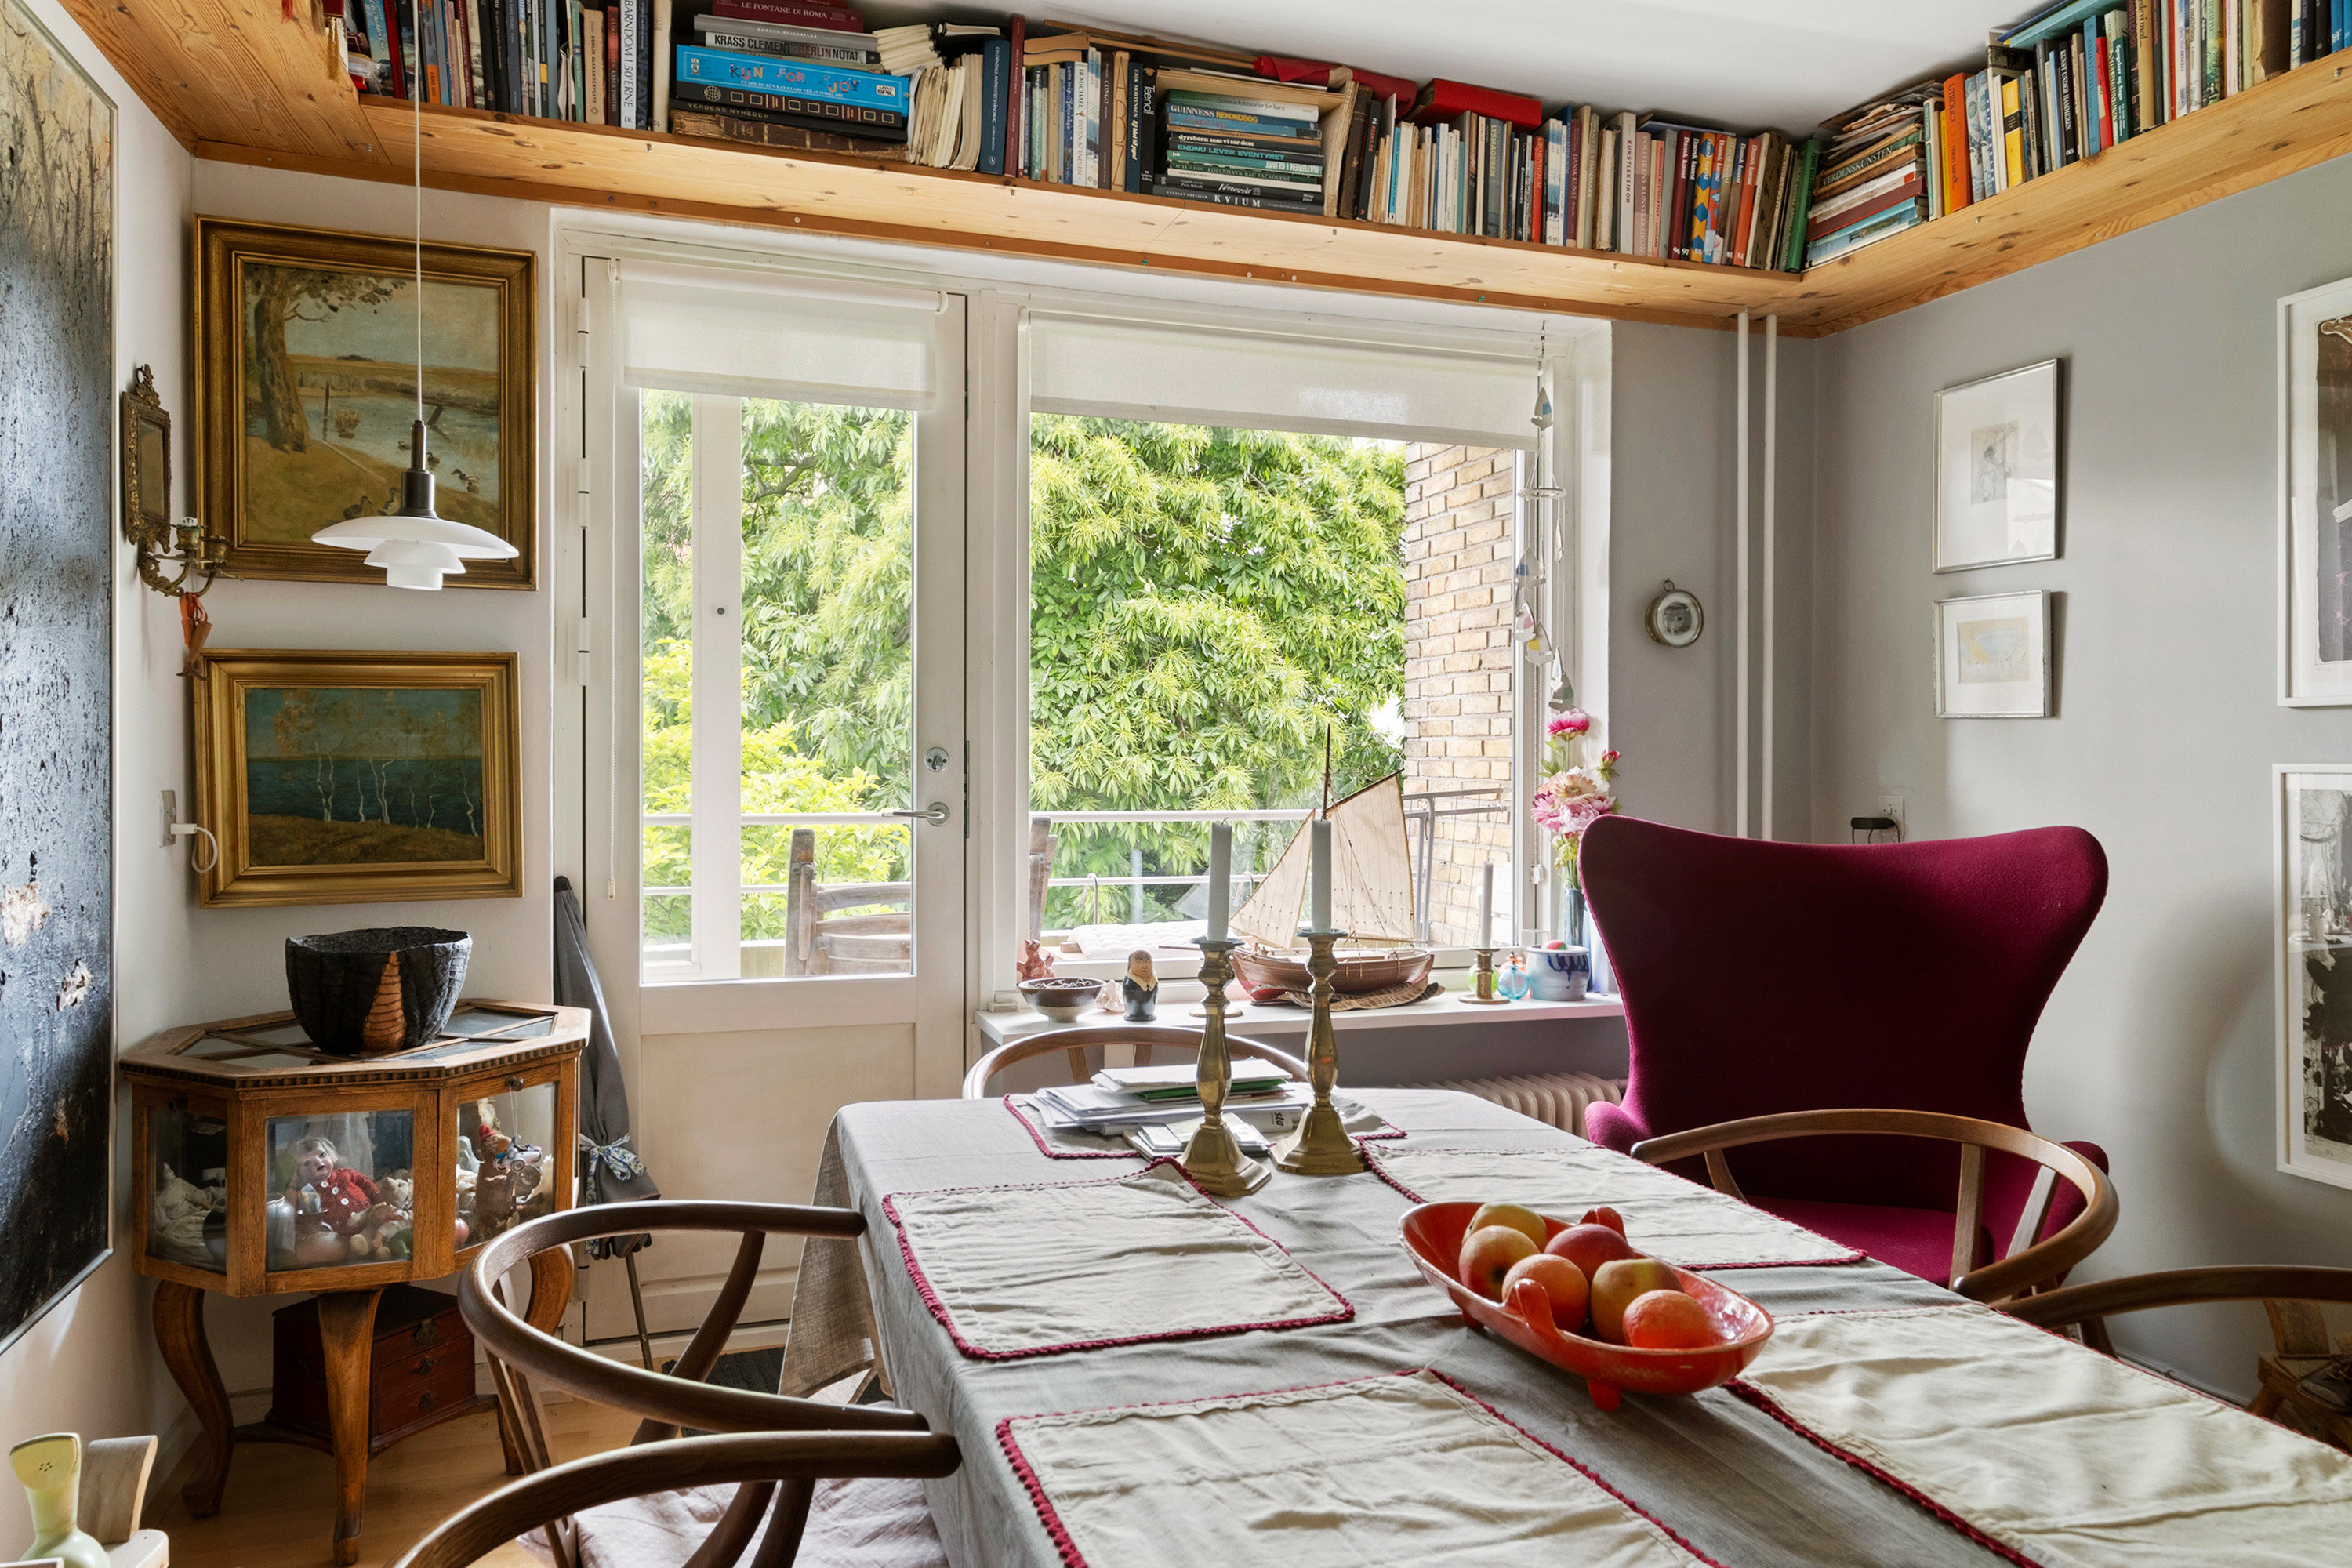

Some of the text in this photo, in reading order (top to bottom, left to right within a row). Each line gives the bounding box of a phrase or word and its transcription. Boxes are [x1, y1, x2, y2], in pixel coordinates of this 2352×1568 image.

[753, 3, 791, 14] FONTANE
[804, 9, 828, 20] ROMA
[624, 0, 633, 56] BARNDOM
[714, 34, 745, 48] KRASS
[747, 38, 792, 53] CLEMENT
[2060, 49, 2068, 71] KUNST
[729, 63, 764, 81] KUN
[777, 67, 806, 85] FOR
[2061, 71, 2070, 95] UNDER
[624, 66, 633, 107] 50'ERNE
[688, 103, 770, 118] VERDENS NYHEDER
[1170, 104, 1258, 123] GUINNESS REKORDBOG
[2063, 95, 2071, 131] HAMMEREN
[1177, 144, 1285, 160] ENDNU LEVER EVENTYRET
[1681, 136, 1690, 158] Dansk
[1691, 138, 1700, 159] Dansk
[1704, 138, 1713, 159] Dansk
[1716, 140, 1726, 162] Dansk
[1738, 143, 1747, 163] Dansk
[1749, 144, 1758, 165] Dansk
[1290, 163, 1319, 174] NATUREN
[1690, 160, 1698, 180] kunst
[1702, 160, 1711, 180] kunst
[1714, 162, 1723, 182] kunst
[1736, 165, 1744, 183] kunst
[1747, 165, 1755, 186] kunst
[1823, 147, 1893, 187] VERDENSKUNSTEN
[1213, 194, 1261, 207] KVIUM
[1639, 186, 1648, 253] KUNSTLEKSIKON
[1672, 246, 1681, 255] 96
